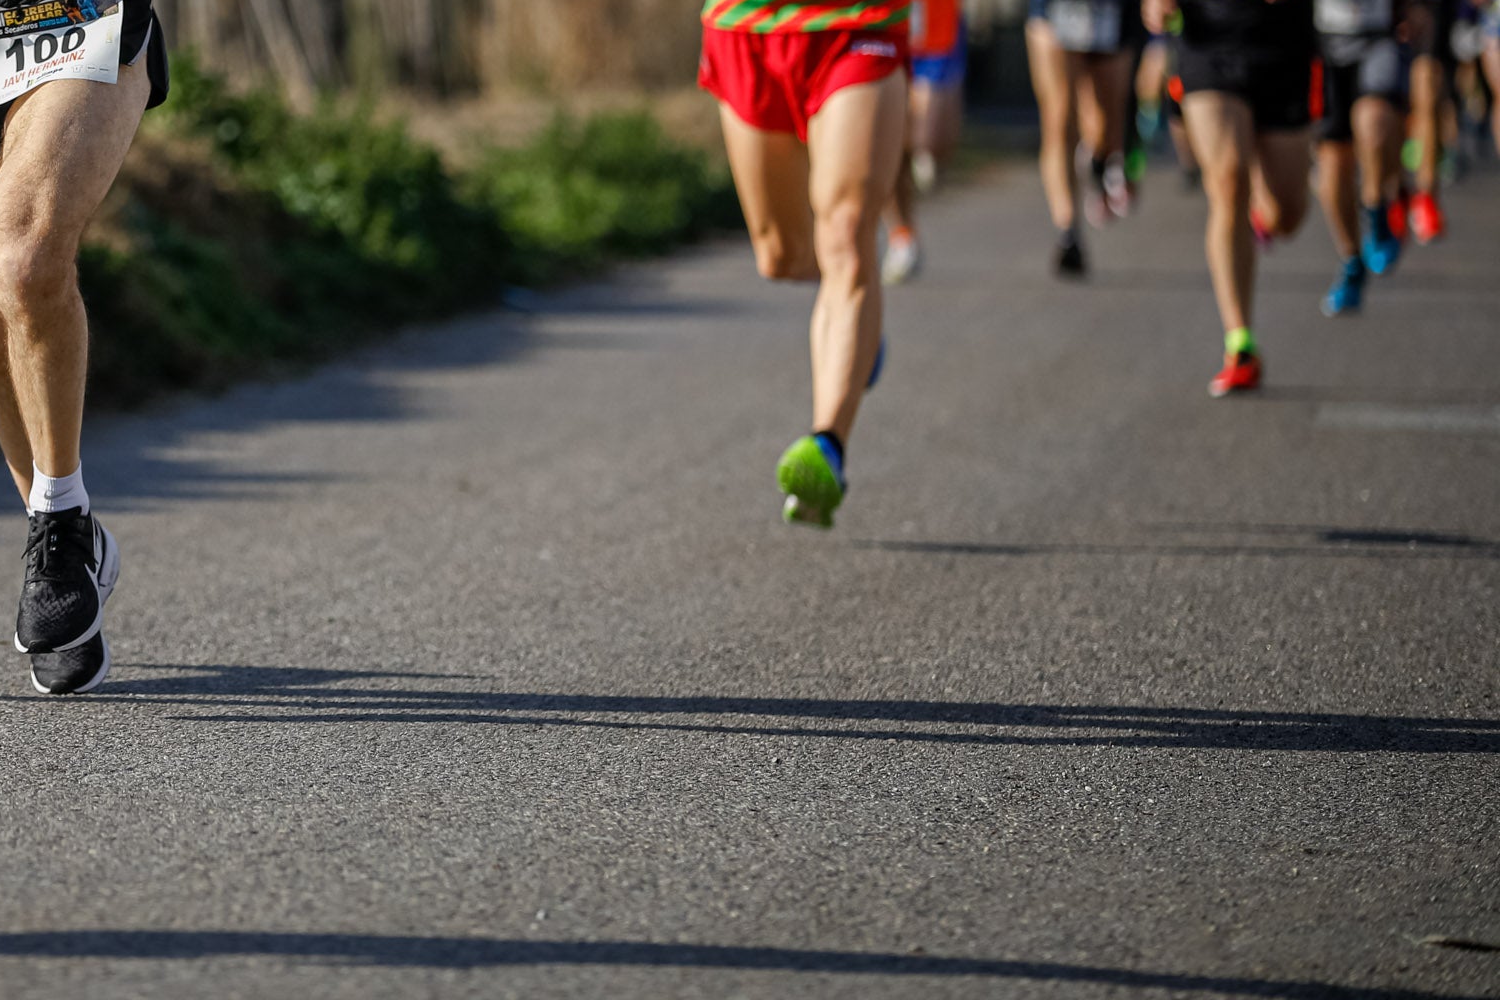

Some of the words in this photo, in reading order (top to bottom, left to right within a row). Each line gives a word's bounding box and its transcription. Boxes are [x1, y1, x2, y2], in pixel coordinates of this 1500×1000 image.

[4, 1, 62, 18] CARERA
[4, 21, 38, 35] Secaderos
[6, 27, 86, 72] 100
[2, 73, 26, 90] JAVI
[27, 48, 86, 77] HERNAINZ
